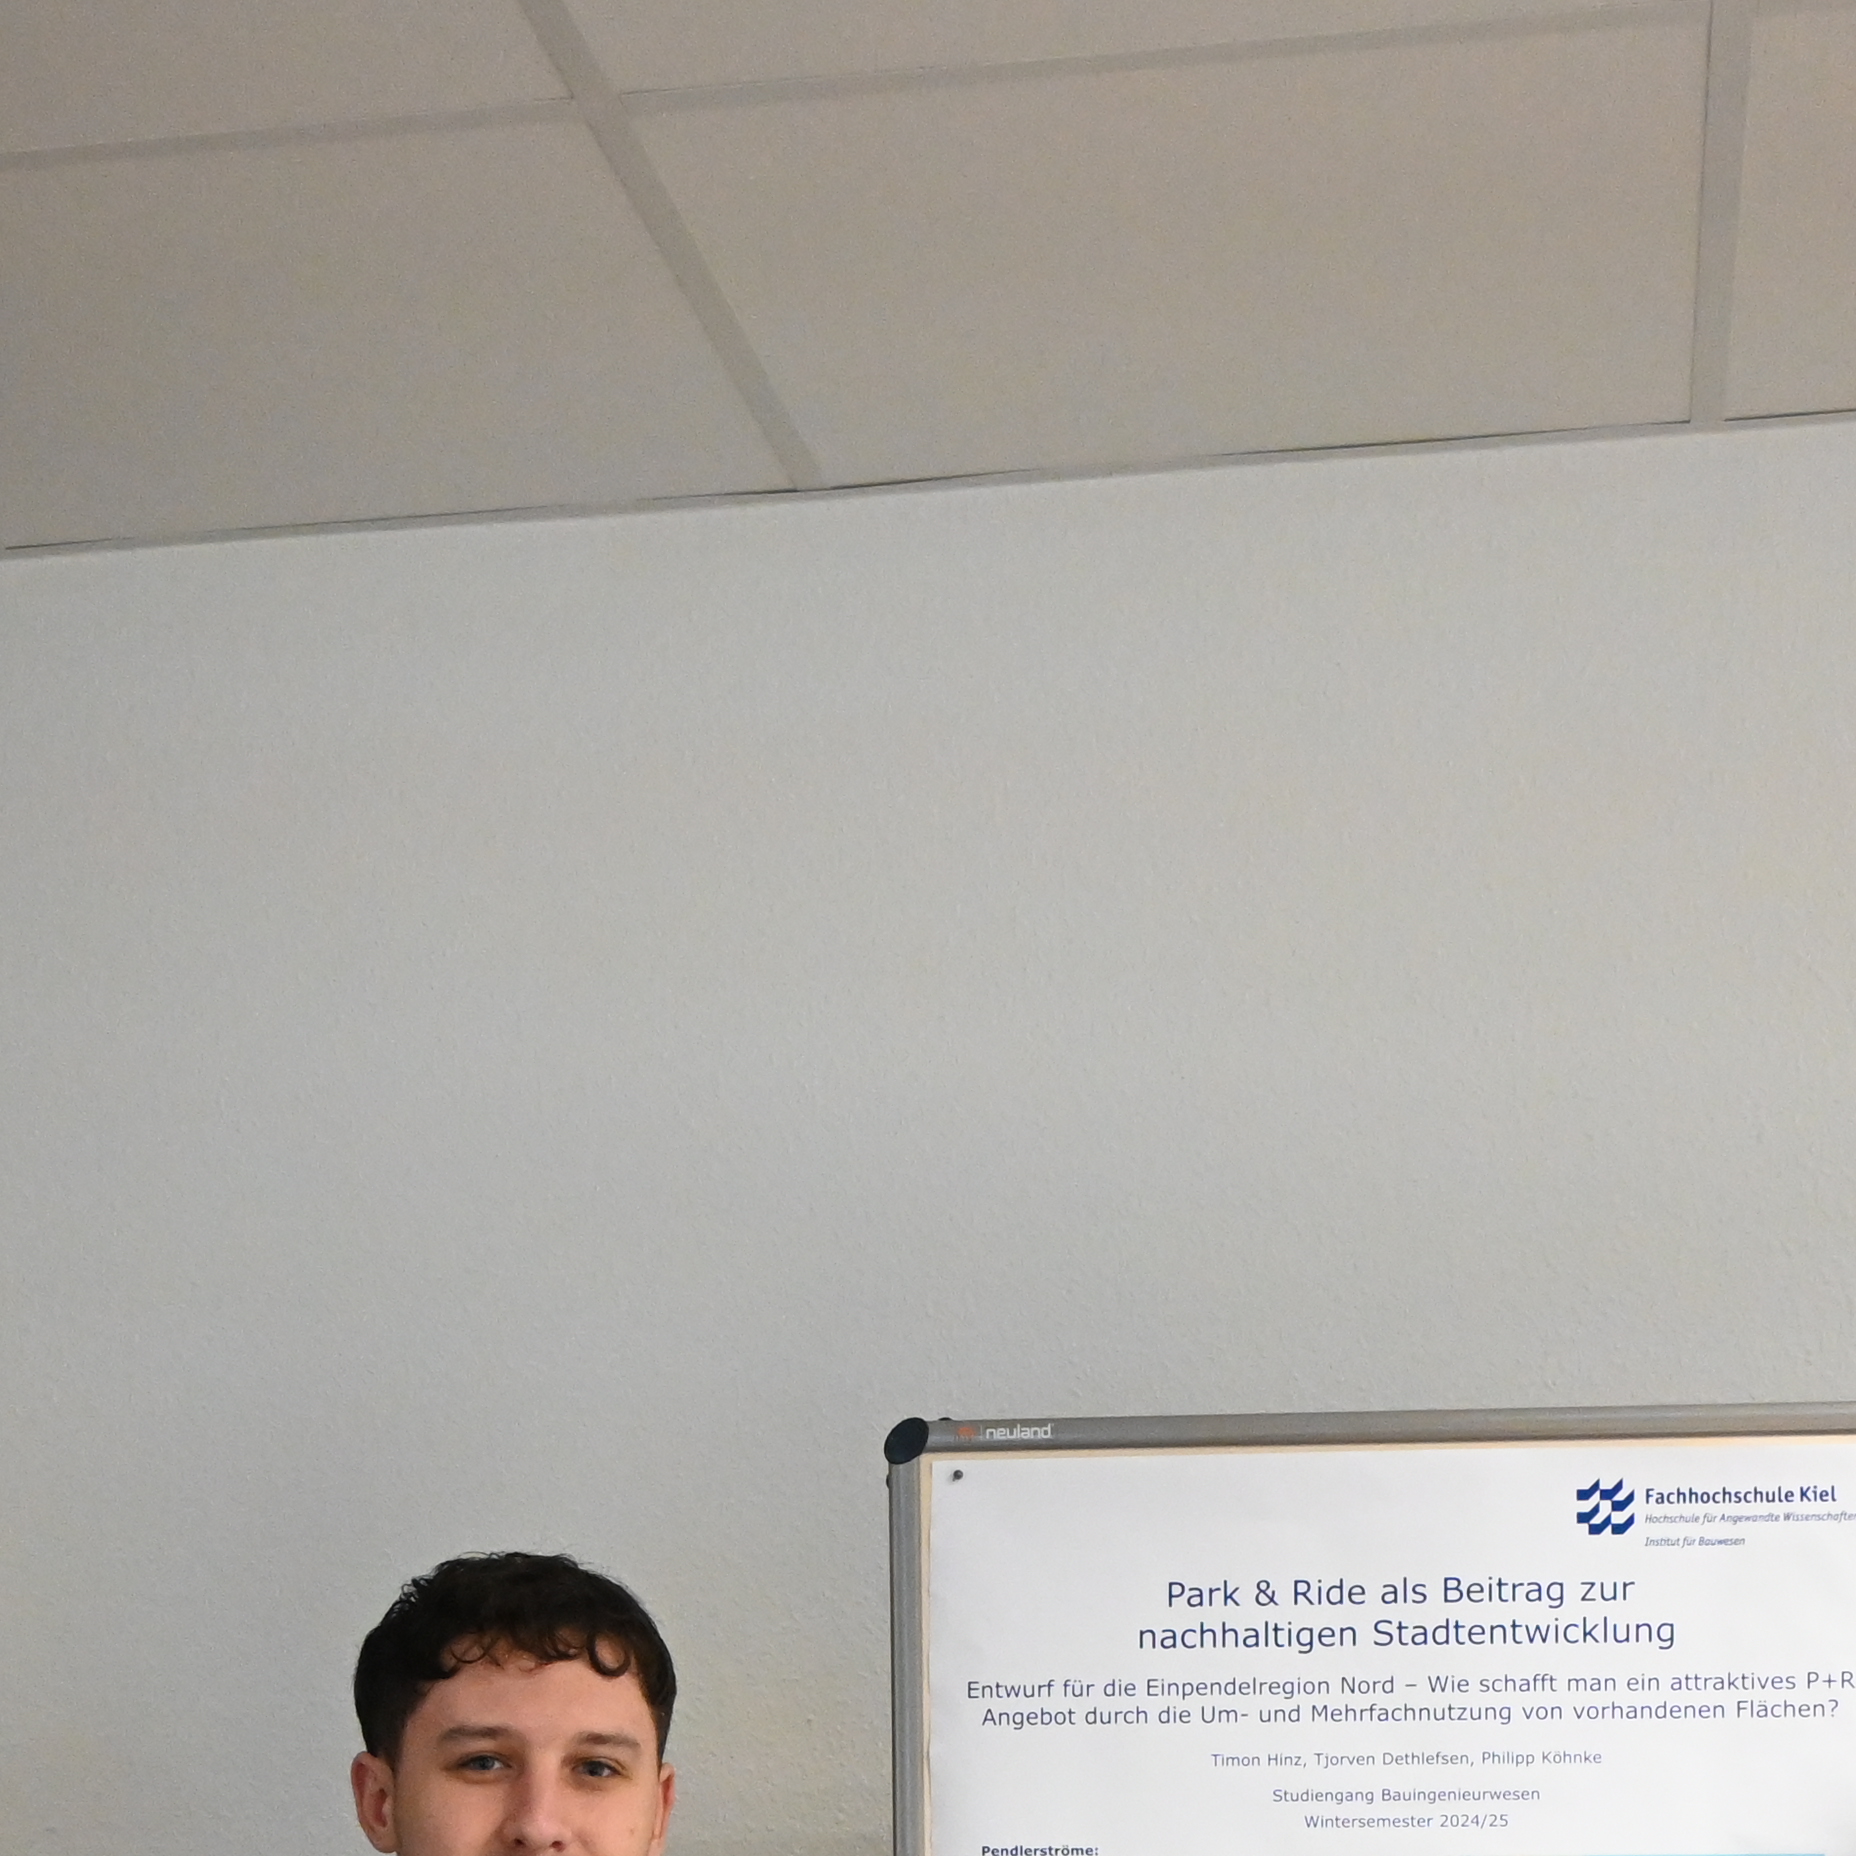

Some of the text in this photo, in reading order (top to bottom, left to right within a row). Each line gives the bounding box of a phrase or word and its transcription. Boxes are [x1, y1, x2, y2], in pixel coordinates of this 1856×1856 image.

[986, 1423, 1051, 1439] neuland
[1645, 1484, 1837, 1505] Fachhochschule Kiel
[1644, 1512, 1700, 1524] Hochschule
[1700, 1512, 1718, 1525] für
[1718, 1512, 1781, 1525] Angewandte
[1680, 1535, 1696, 1548] für
[1697, 1535, 1746, 1546] Bauwesen
[1168, 1576, 1635, 1609] Park & Ride als Beitrag zur
[1139, 1615, 1674, 1654] nachhaltigen Stadtentwicklung
[967, 1678, 1055, 1699] Entwurf
[1062, 1678, 1095, 1698] für
[1102, 1678, 1136, 1697] die
[1146, 1676, 1329, 1700] Einpendelregion
[1340, 1675, 1394, 1694] Nord
[1427, 1674, 1469, 1693] Wie
[1478, 1672, 1557, 1693] schafft
[1567, 1677, 1616, 1692] man
[1626, 1672, 1659, 1692] ein
[1670, 1671, 1796, 1691] attraktives
[1806, 1670, 1855, 1689] P+R
[981, 1698, 1838, 1730] Angebot durch die Um- und Mehrfachnutzung von vorhandenen Flächen?
[1210, 1750, 1602, 1769] Timon Hinz, Tjorven Dethlefsen, Philipp Köhnke
[1272, 1788, 1540, 1805] Studiengang Bauingenieurwesen
[1303, 1813, 1508, 1829] Wintersemester 2024/25
[981, 1844, 1098, 1856] Pendlerströme:
